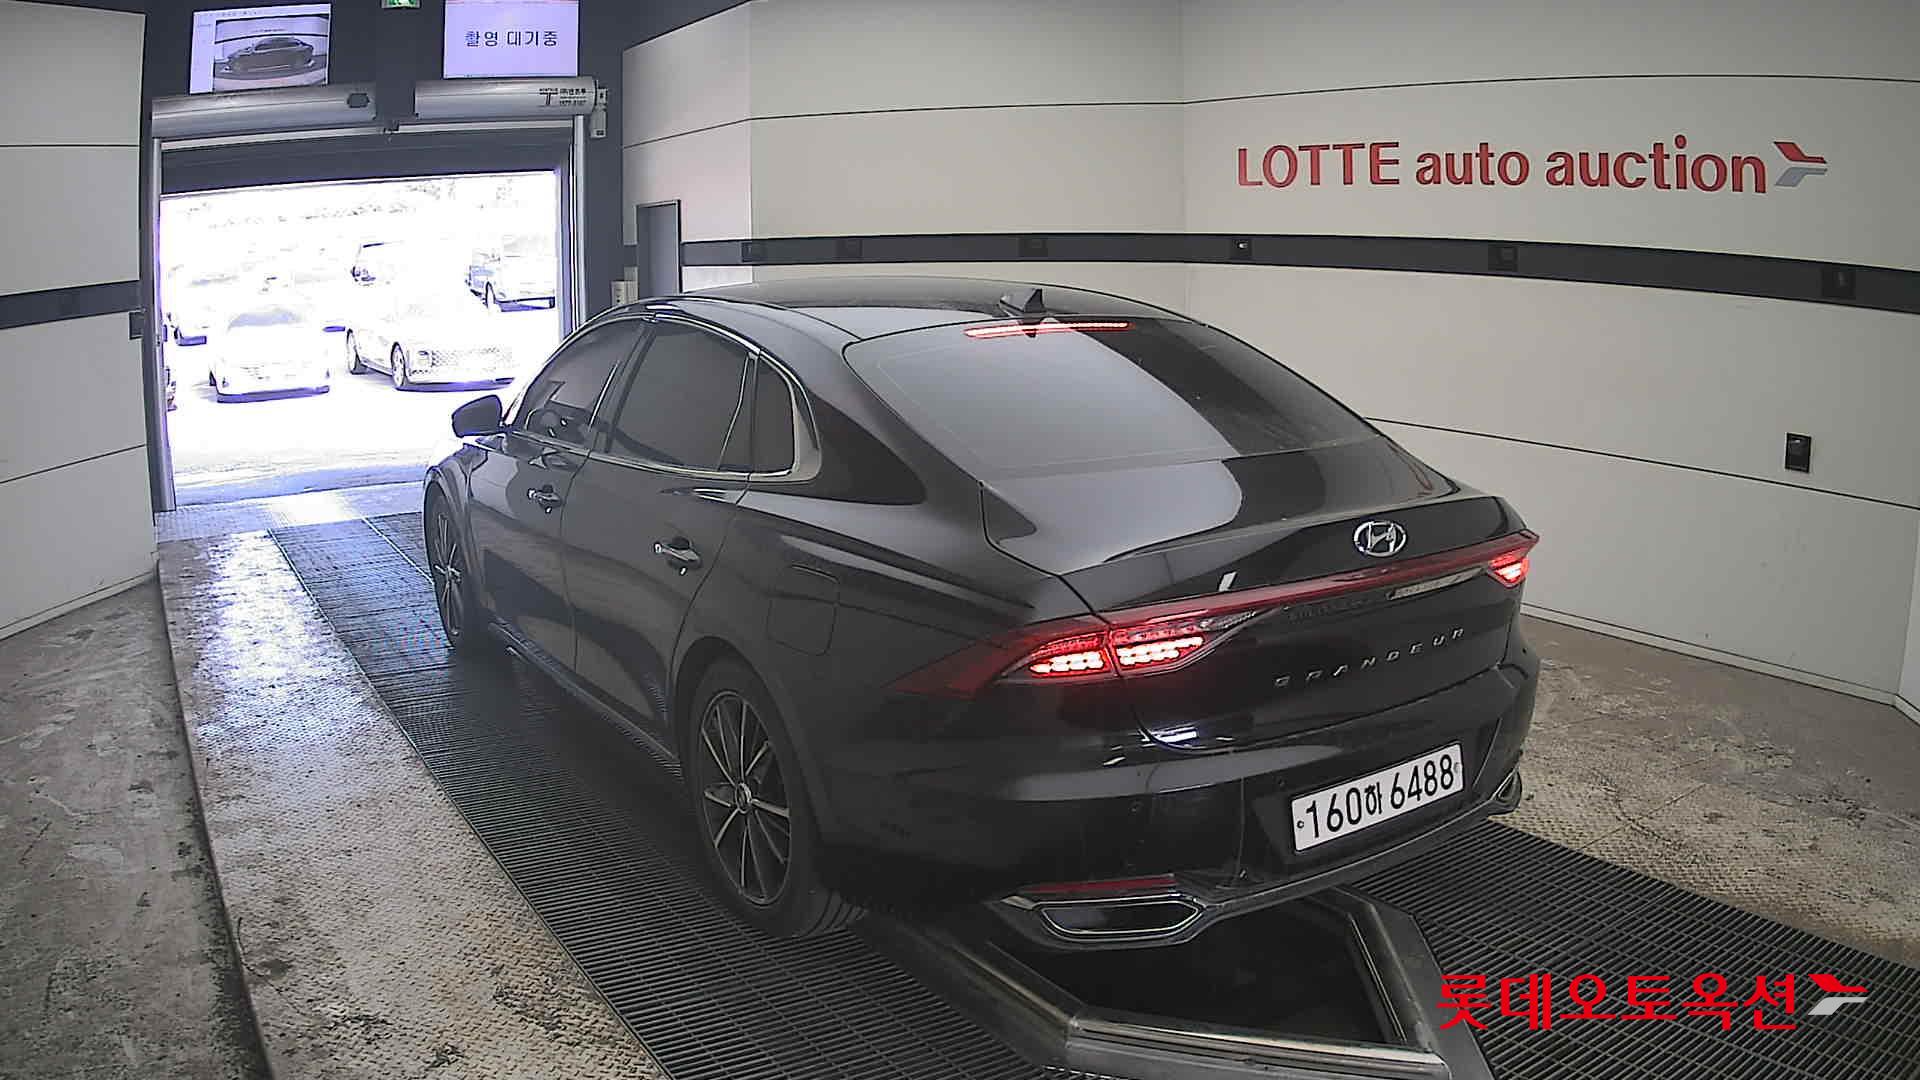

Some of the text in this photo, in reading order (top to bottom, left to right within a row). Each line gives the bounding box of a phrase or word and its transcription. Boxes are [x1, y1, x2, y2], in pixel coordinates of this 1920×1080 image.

[465, 31, 558, 47] 촬영 대기중
[1237, 134, 1767, 193] LOTTE auto auction
[1273, 627, 1464, 687] GRANDEUR
[1390, 754, 1454, 810] 6488
